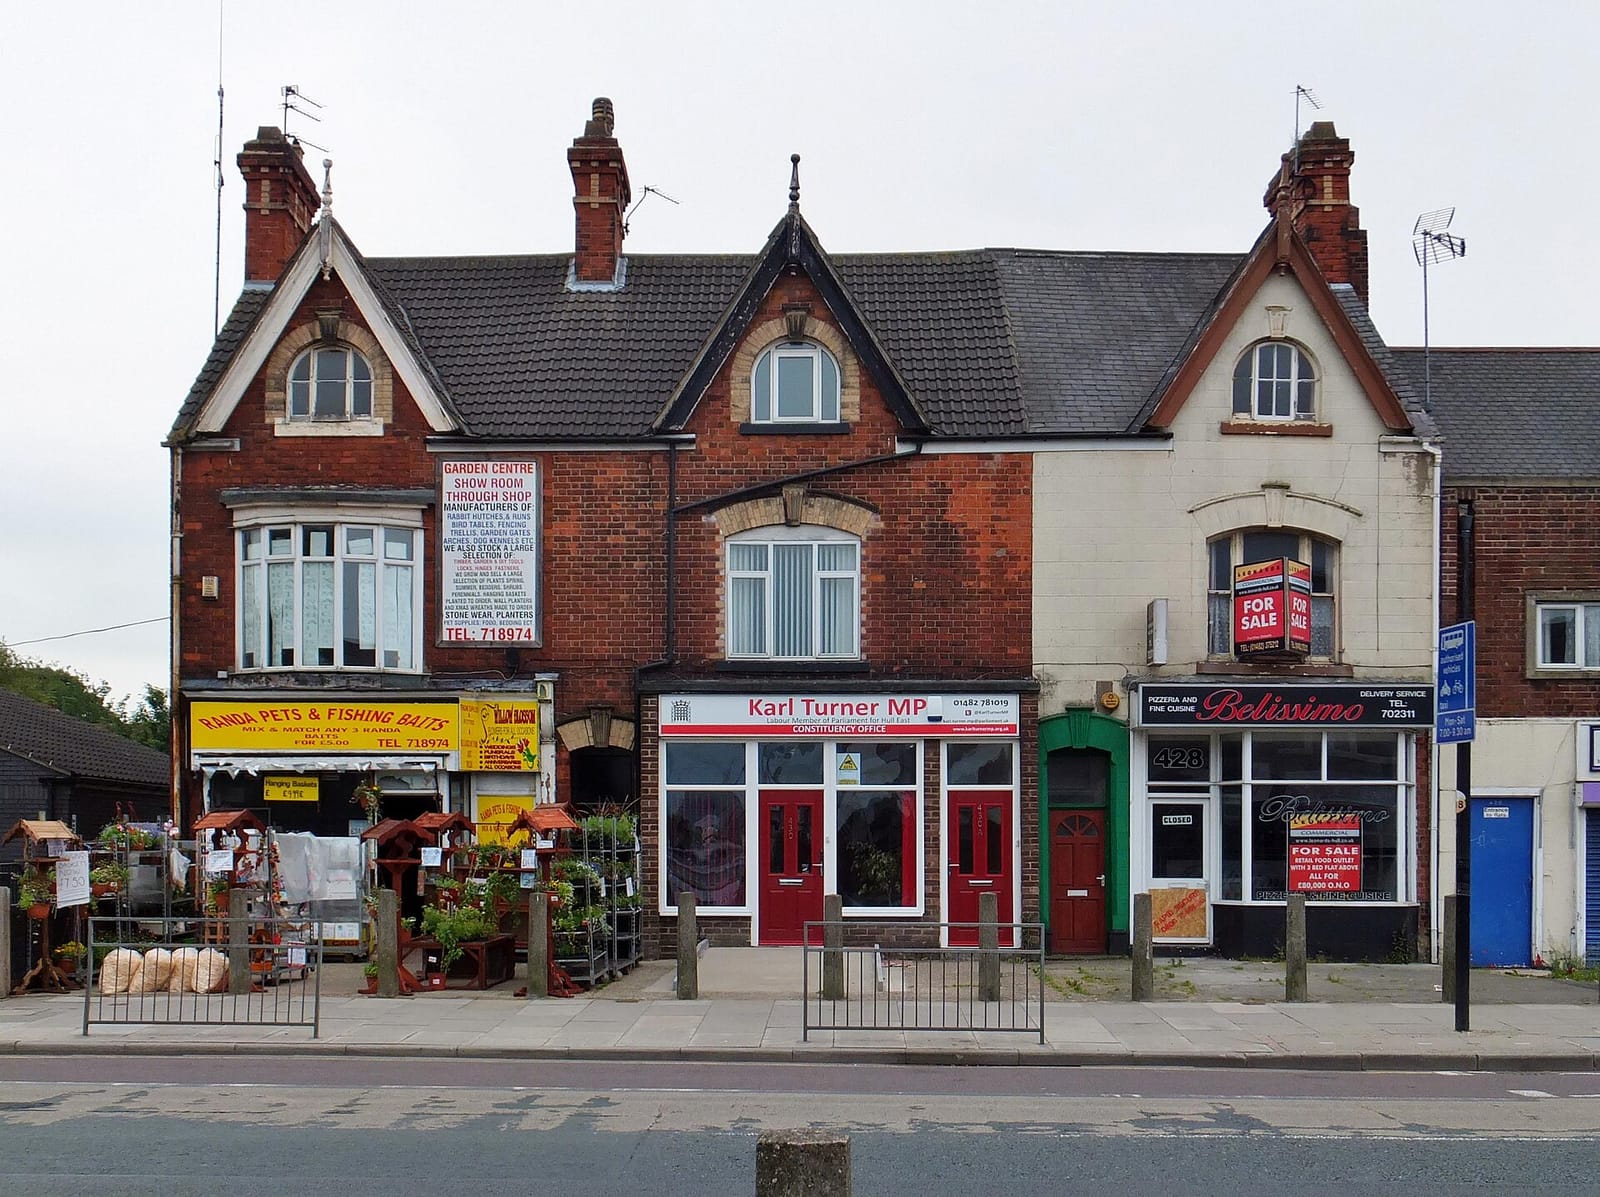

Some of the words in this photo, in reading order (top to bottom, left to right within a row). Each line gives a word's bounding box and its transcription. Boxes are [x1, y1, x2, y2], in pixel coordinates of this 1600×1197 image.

[444, 464, 488, 474] GARDEN
[492, 464, 534, 474] CENTRE
[454, 478, 487, 488] SHOW
[491, 478, 523, 488] ROOM
[447, 492, 498, 502] THROUGH
[502, 492, 532, 502] SHOP
[444, 503, 518, 511] MANUFACTURERS
[1243, 597, 1274, 614] FOR
[1293, 597, 1306, 613] FOR
[1241, 612, 1277, 630] SALE
[1291, 613, 1307, 629] SALE
[446, 628, 476, 640] TEL:
[481, 628, 532, 640] 718974
[748, 698, 794, 716] Karl
[801, 698, 879, 716] Turner
[888, 698, 927, 716] MP
[1196, 688, 1364, 721] Belissimo
[198, 712, 257, 730] RANDA
[259, 708, 302, 722] PETS
[308, 708, 320, 720] &
[328, 708, 394, 724] FISHING
[397, 714, 450, 731] BAITS
[1381, 710, 1416, 718] 702311
[377, 738, 401, 748] TEL
[407, 738, 449, 748] 718974
[1153, 748, 1204, 769] 428
[1259, 795, 1390, 822] Belissimo
[1163, 816, 1192, 824] CLOSED
